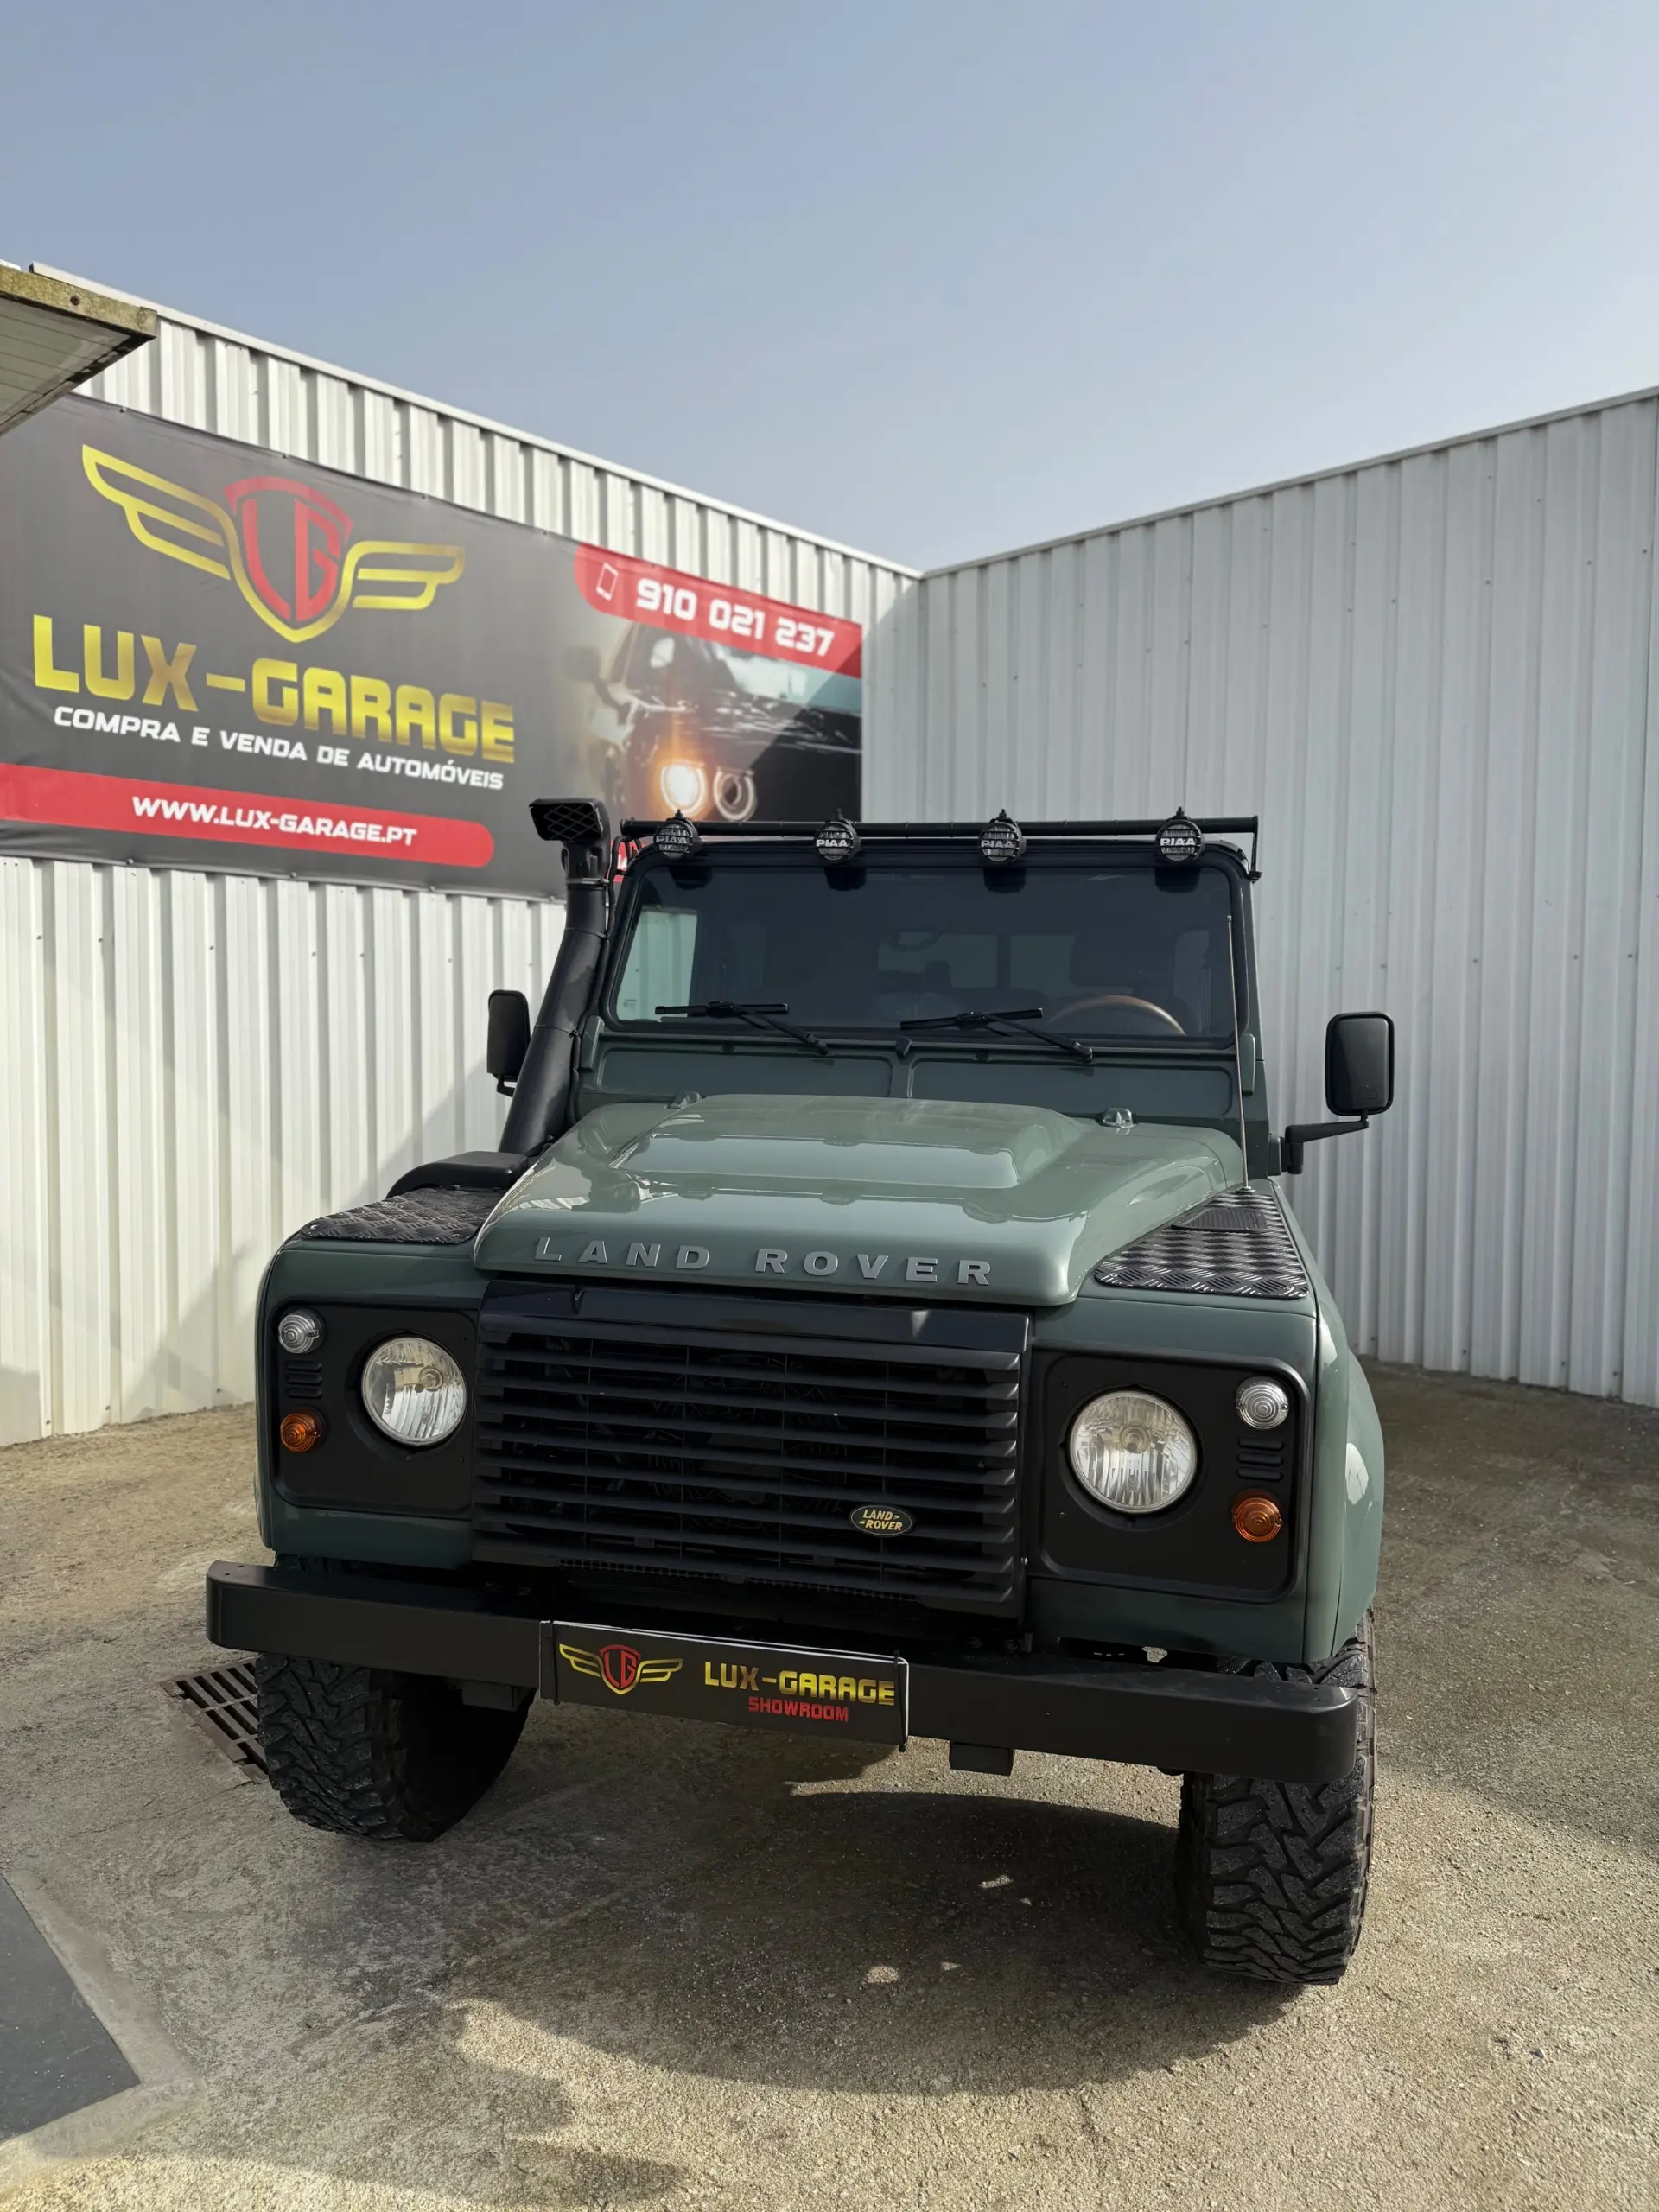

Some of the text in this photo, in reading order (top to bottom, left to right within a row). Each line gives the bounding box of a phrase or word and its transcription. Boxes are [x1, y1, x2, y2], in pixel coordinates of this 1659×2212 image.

[636, 578, 834, 657] 910 021 237
[33, 614, 515, 764] LUX-GARAGE
[54, 706, 504, 791] COMPRA E VENDA DE AUTOMÓVEIS
[132, 796, 417, 846] WWW.LUX-GARAGE.PT
[655, 836, 688, 844] PIAA
[816, 839, 848, 848] PIAA
[1160, 837, 1196, 847] PIAA
[981, 840, 1015, 849] PIAA
[534, 1237, 991, 1286] LAND ROVER
[703, 1661, 896, 1707] LUX-GARAGE
[747, 1696, 849, 1723] SHOWROOM
